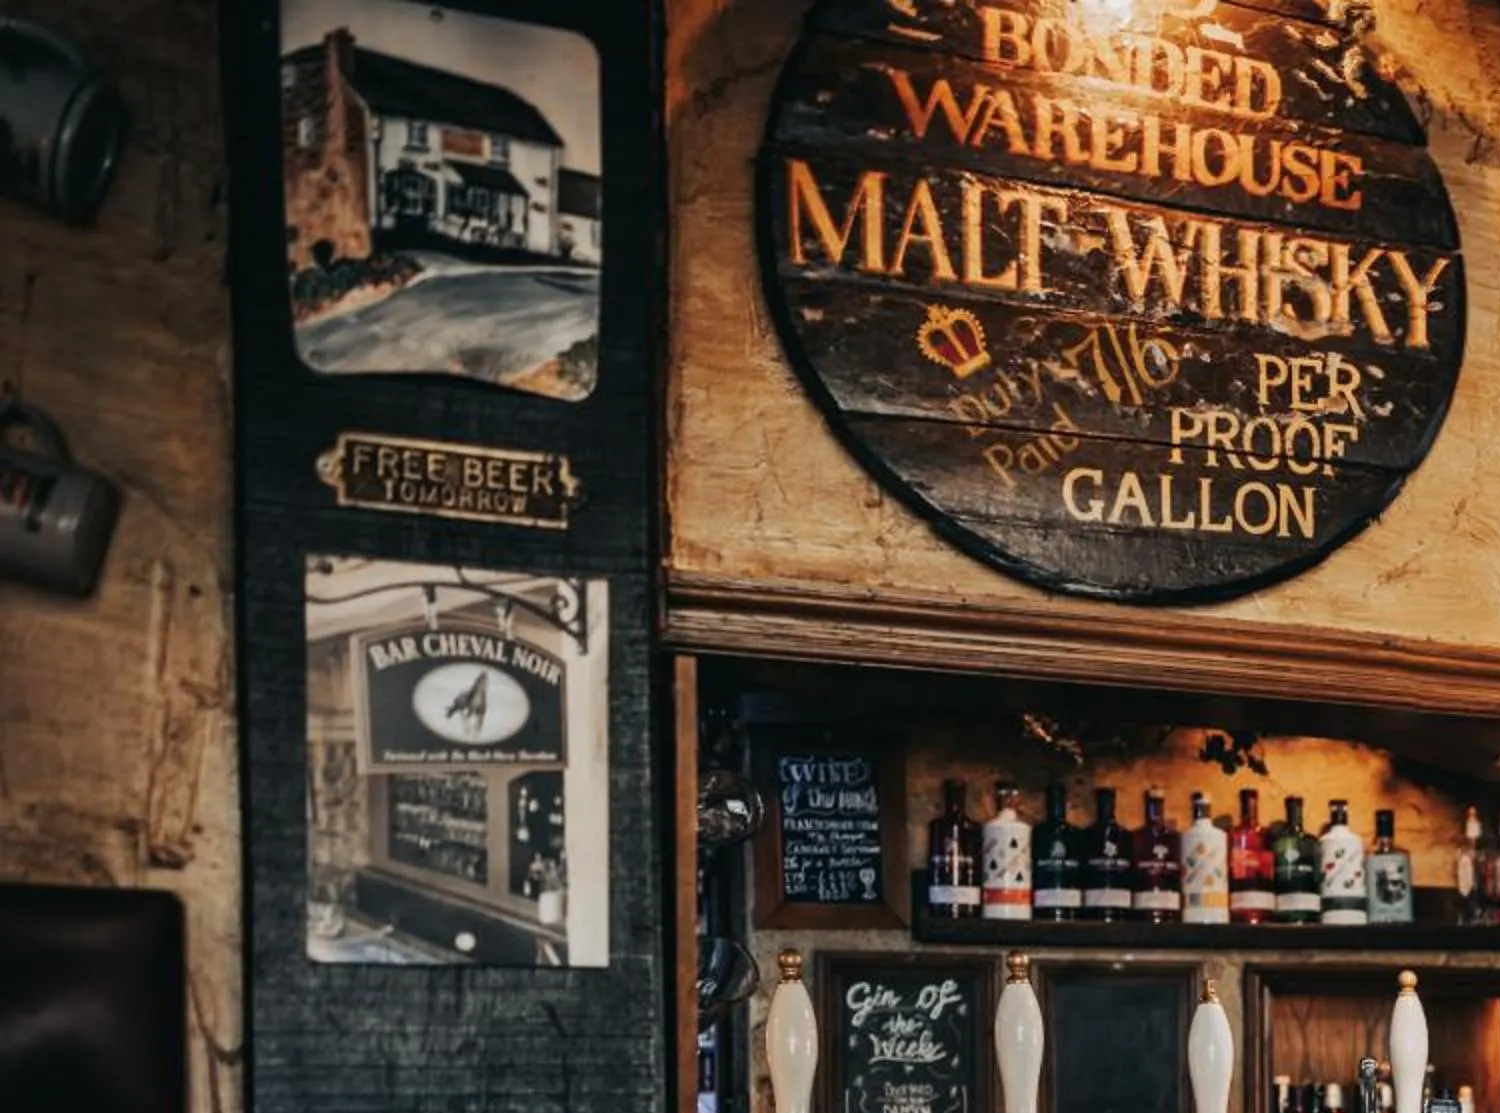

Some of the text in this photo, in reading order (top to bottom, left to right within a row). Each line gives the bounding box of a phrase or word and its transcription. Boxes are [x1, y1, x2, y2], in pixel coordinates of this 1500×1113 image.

[980, 5, 1282, 120] BONDED
[887, 67, 1362, 211] WAREHOUSE
[784, 159, 1450, 352] MALT WHISKY
[1063, 318, 1180, 406] 7/6
[1254, 352, 1363, 418] PER
[352, 445, 554, 497] FREE BEER
[983, 401, 1082, 489] Paid
[1166, 406, 1359, 478] PROOF
[383, 479, 529, 514] TOMORROW
[1061, 467, 1317, 540] GALLON
[368, 633, 564, 686] BAR CHEVAL NOIR
[846, 981, 902, 1028] Gin
